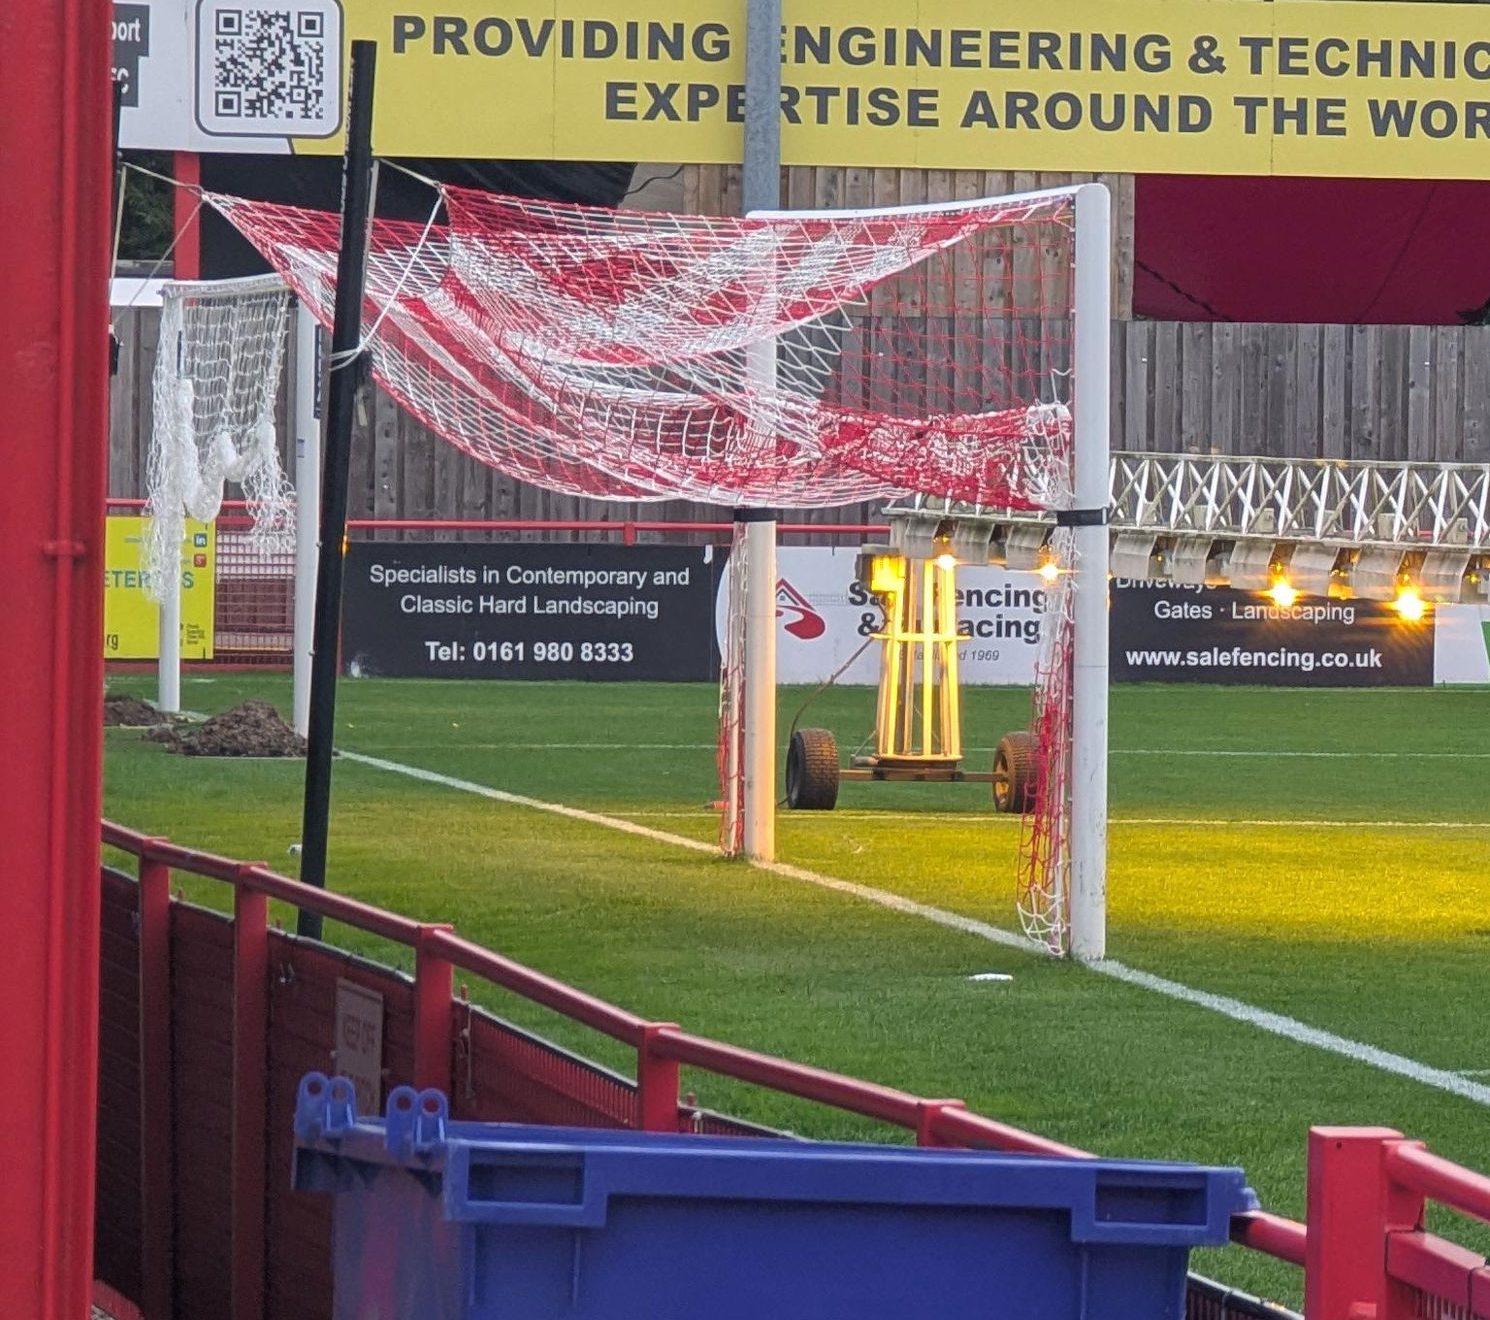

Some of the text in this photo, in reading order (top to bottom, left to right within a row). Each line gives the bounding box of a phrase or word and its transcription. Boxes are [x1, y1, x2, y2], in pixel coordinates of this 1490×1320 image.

[394, 16, 730, 62] PROVIDING
[780, 25, 1171, 73] NGINEERING
[1188, 36, 1226, 74] &
[959, 91, 1212, 133] AROUND
[1234, 97, 1347, 136] THE
[370, 565, 689, 589] Specialists in Contemporary and
[401, 595, 659, 619] Classic Hard Landscaping
[954, 584, 1047, 613] encing
[1154, 601, 1354, 624] Gates Landscaping
[425, 641, 634, 661] Tel: 0161 980 8333
[971, 649, 999, 661] 1969
[1126, 647, 1382, 671] www.salefencing.co.uk
